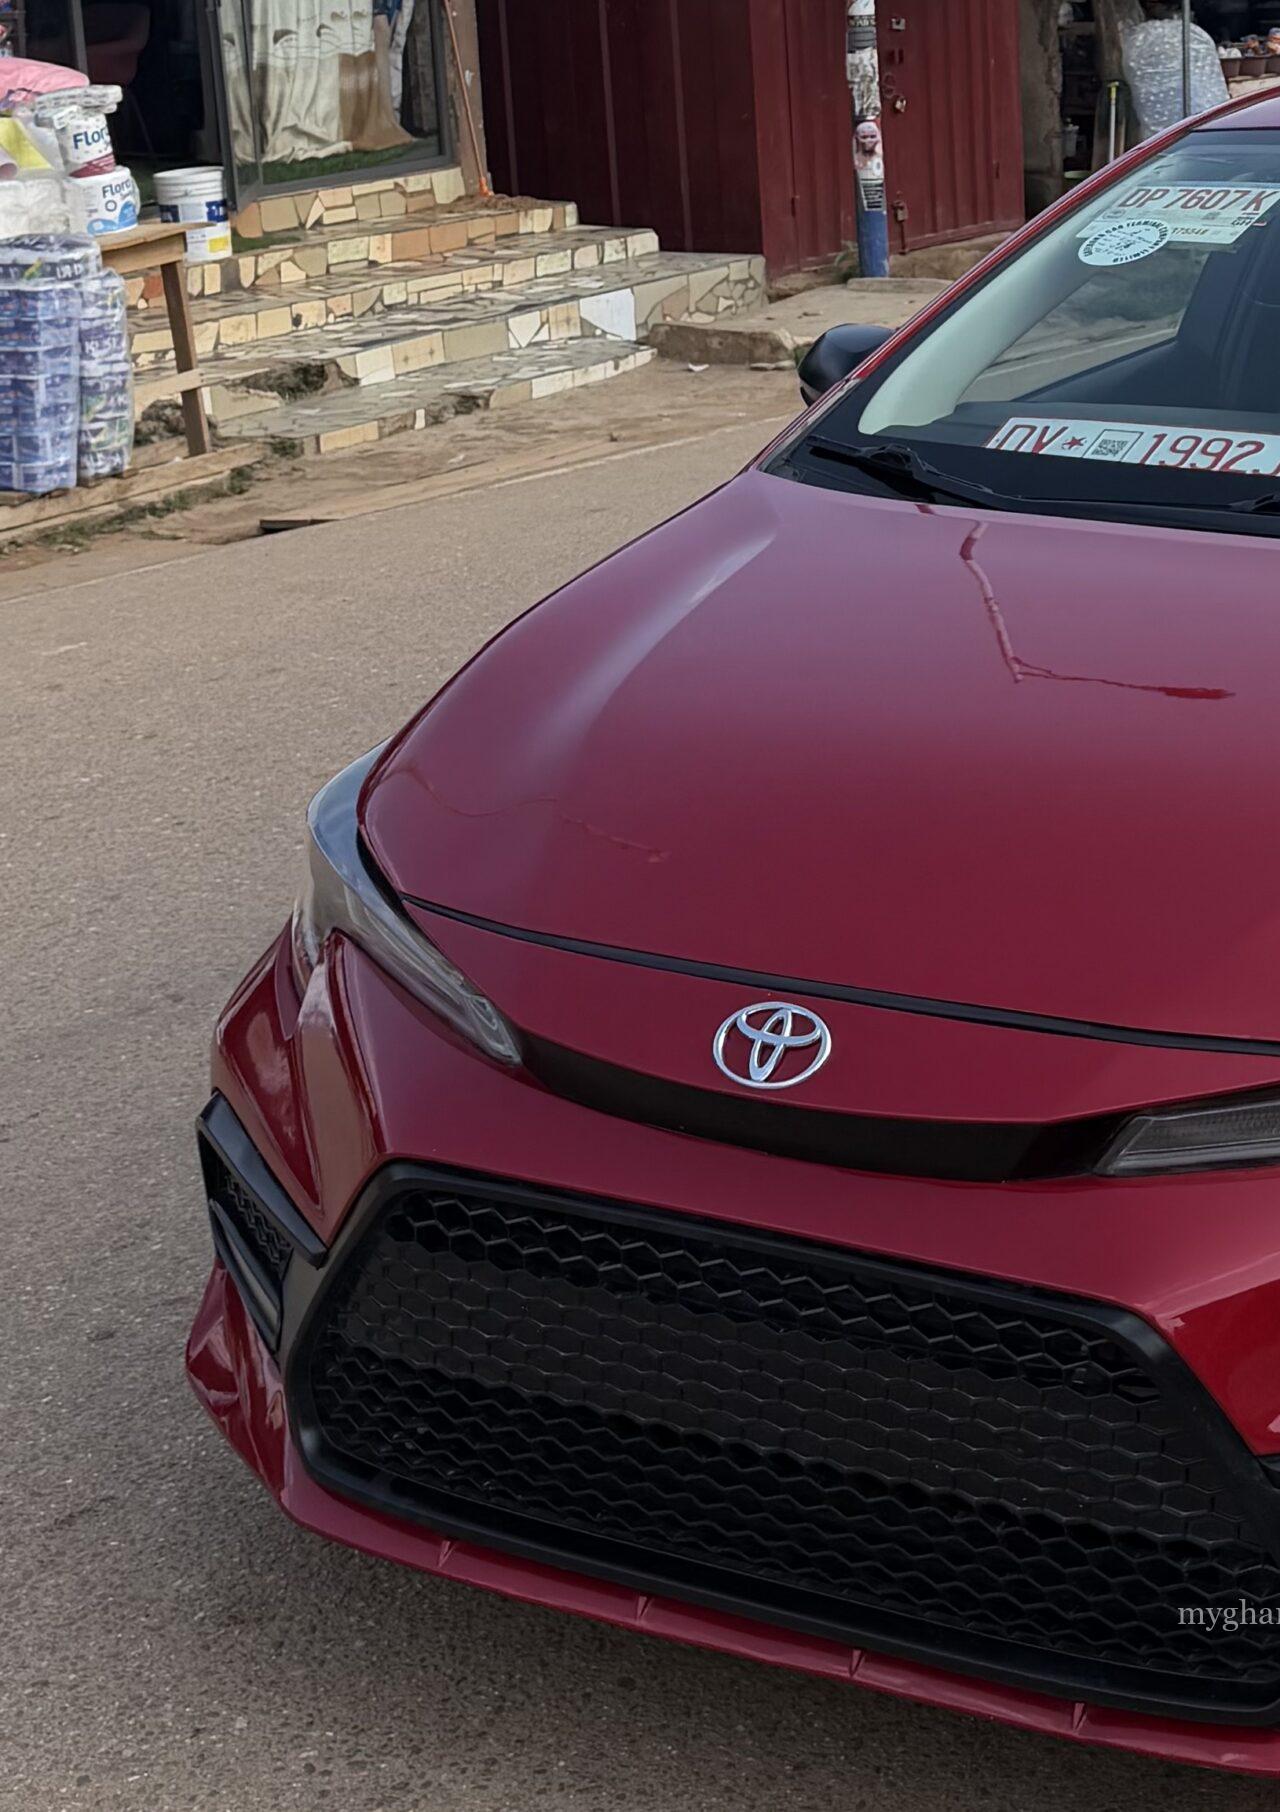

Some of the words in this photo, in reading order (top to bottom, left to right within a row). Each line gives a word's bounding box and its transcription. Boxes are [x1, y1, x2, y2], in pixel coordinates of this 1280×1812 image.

[1118, 188, 1170, 208] DP
[1162, 189, 1250, 210] 7607
[1241, 190, 1280, 211] K
